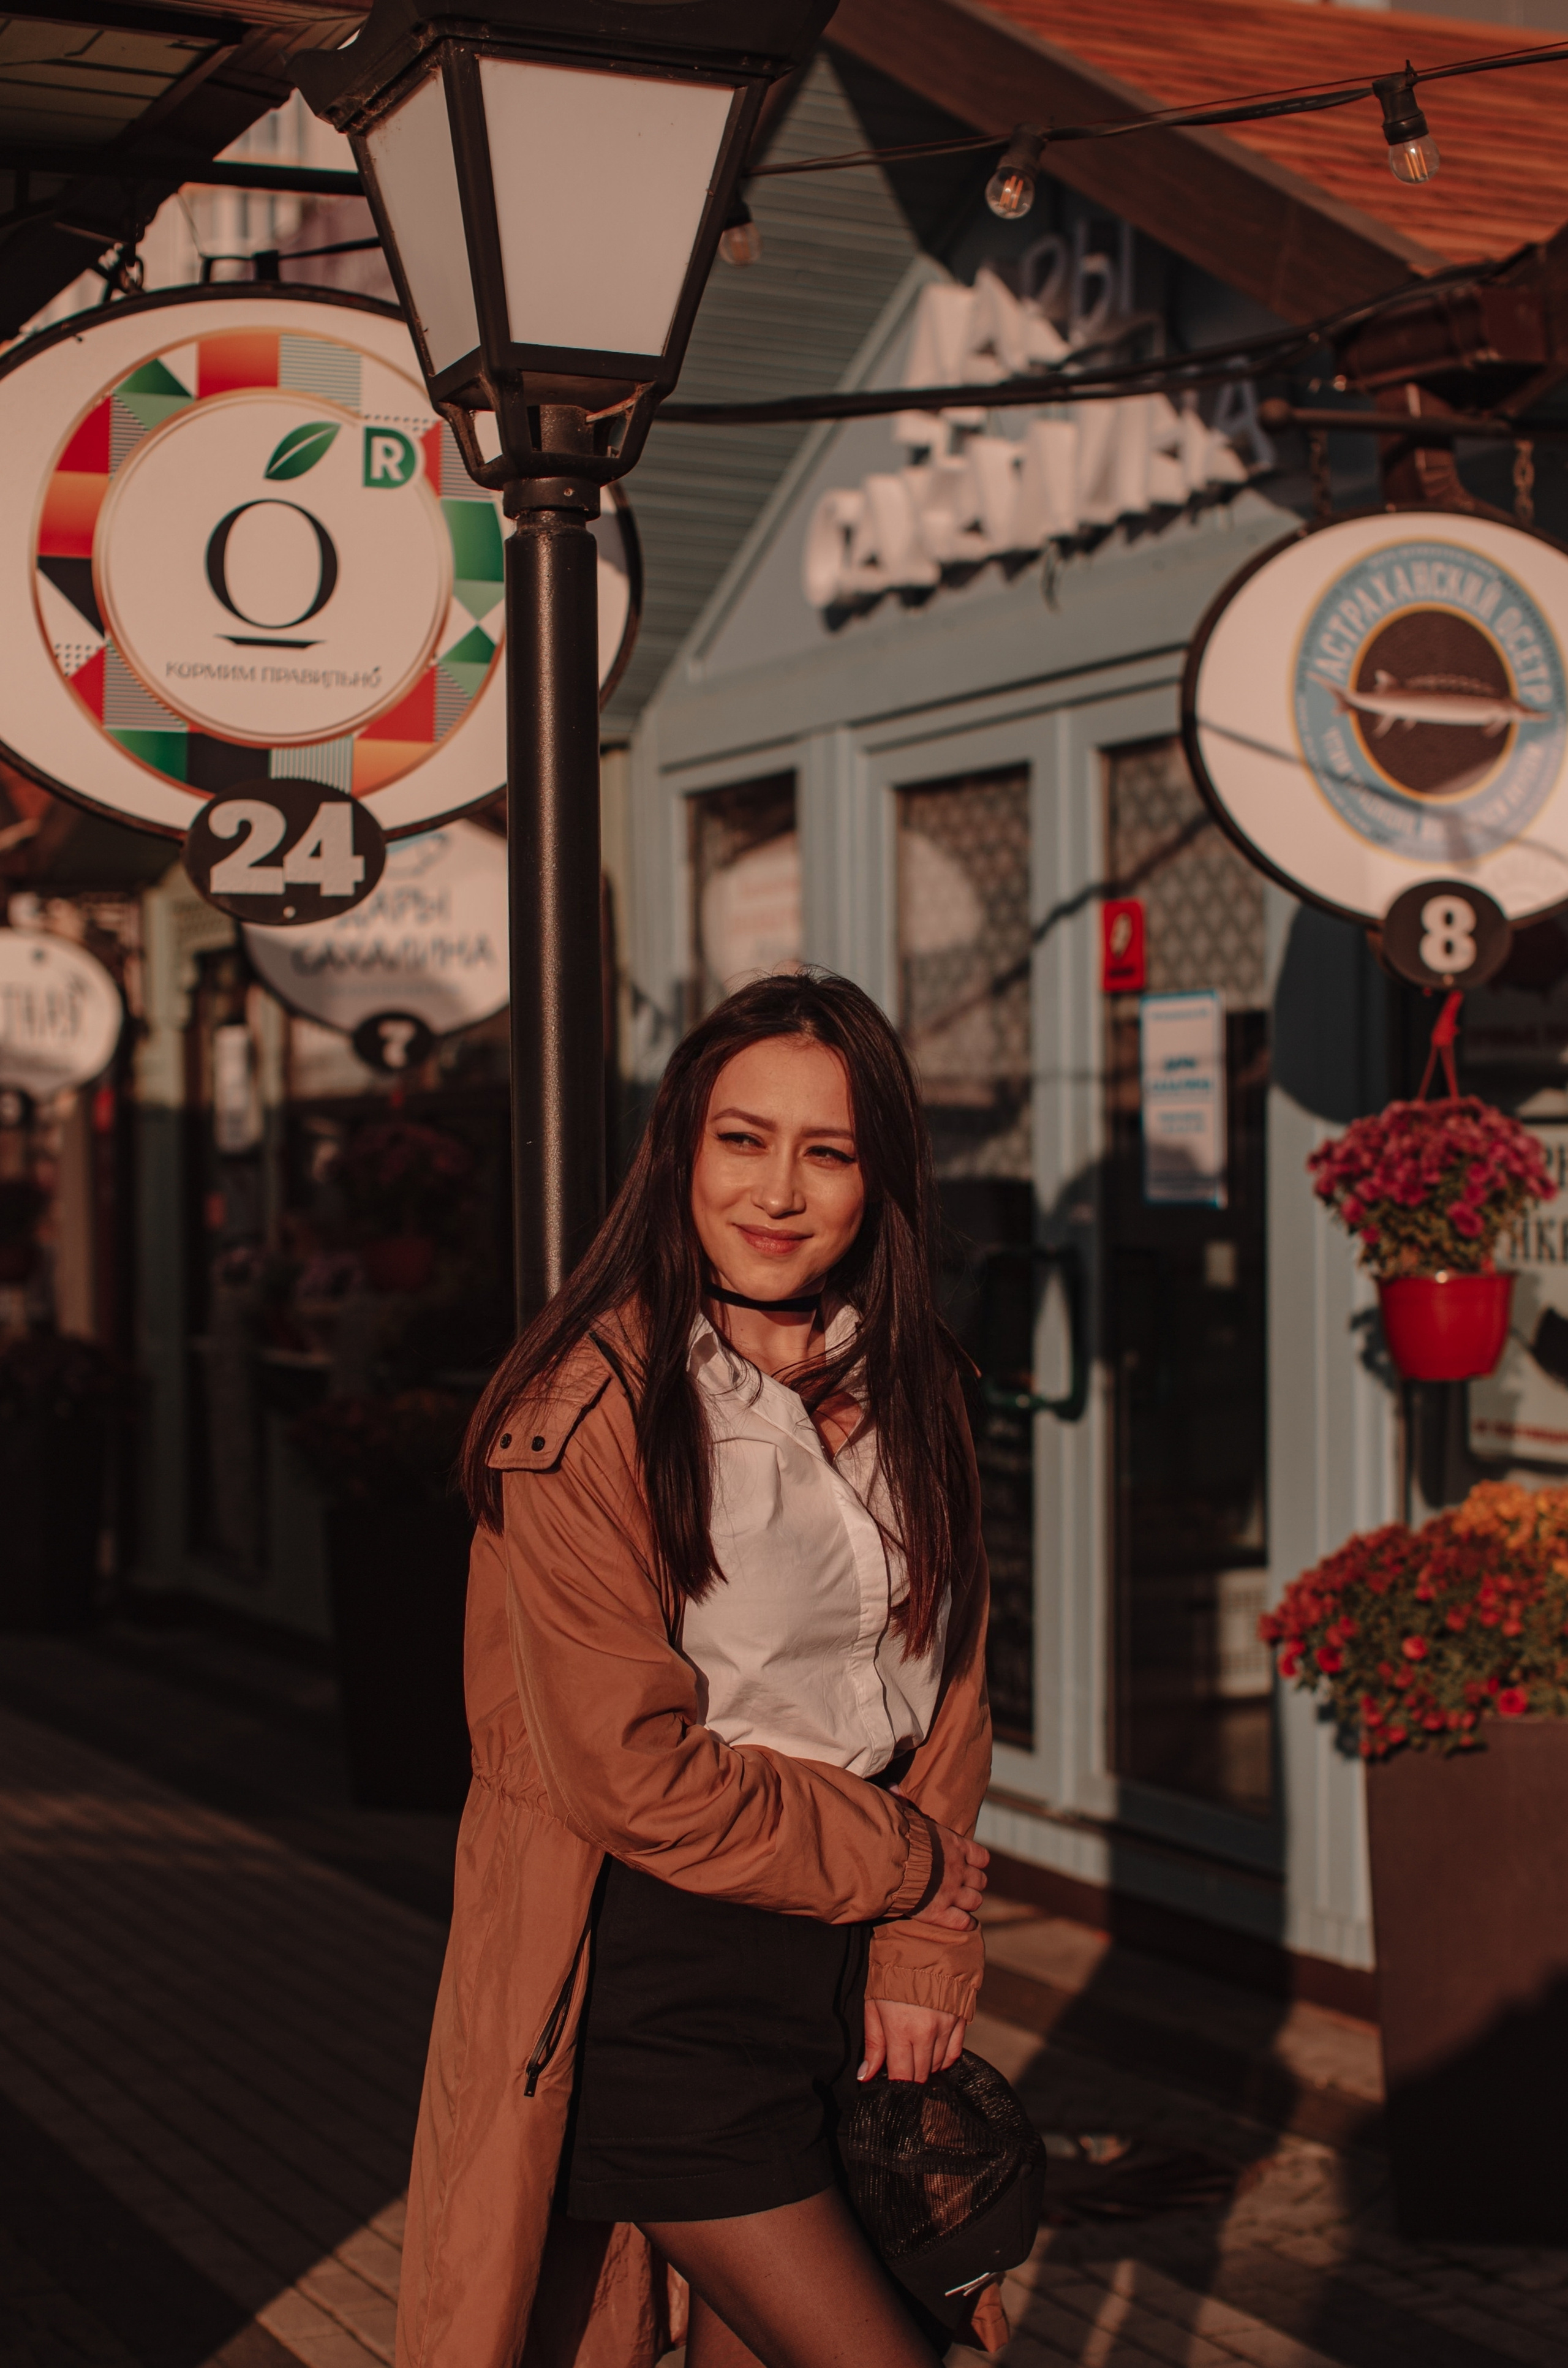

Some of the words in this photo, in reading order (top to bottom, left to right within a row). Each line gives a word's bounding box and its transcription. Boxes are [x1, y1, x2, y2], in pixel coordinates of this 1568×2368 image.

[165, 660, 257, 682] КОРМИМ
[1313, 559, 1504, 682] АСТРАХАНСКИЙ
[1492, 606, 1554, 706] ОСЕТР
[208, 799, 365, 897] 24
[1420, 895, 1477, 975] 8
